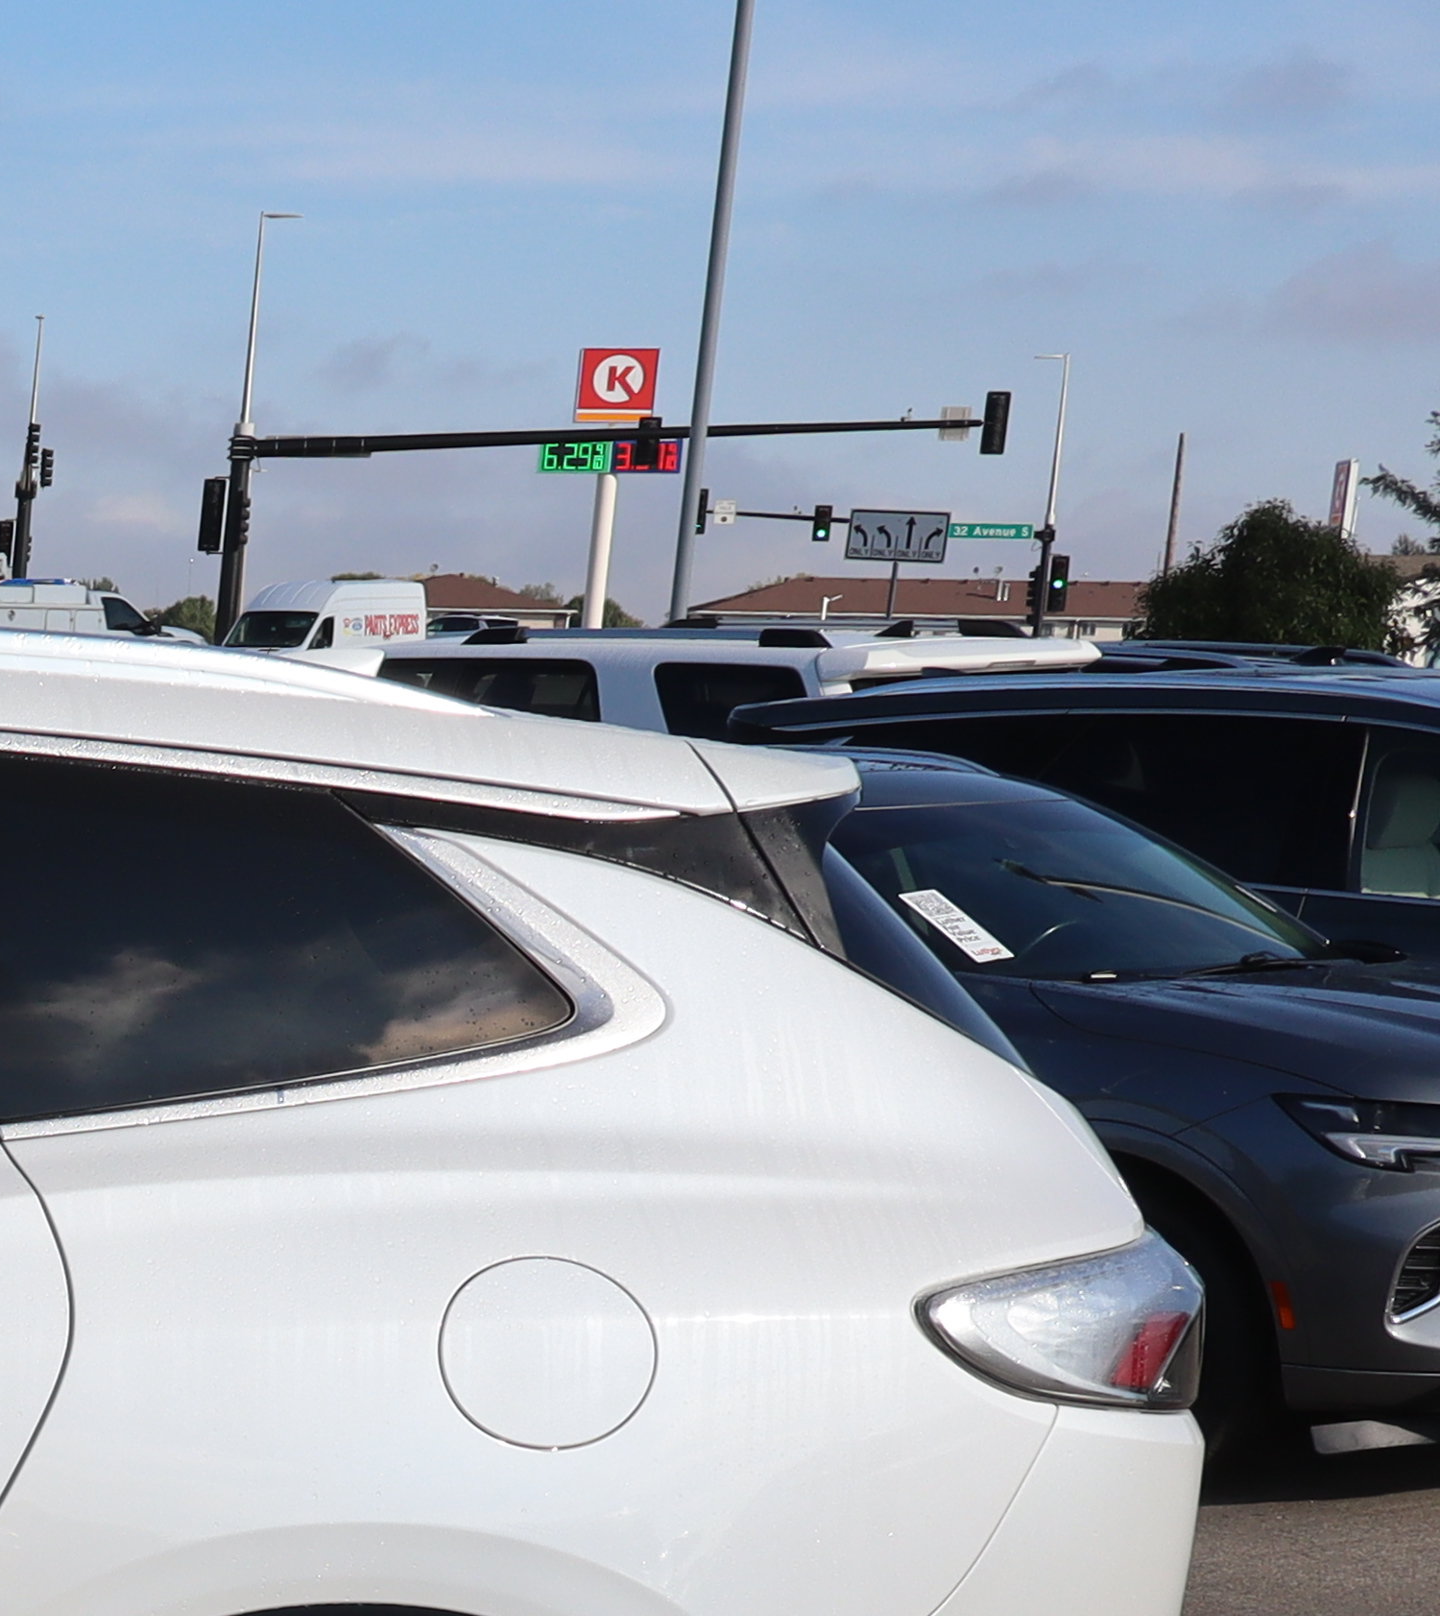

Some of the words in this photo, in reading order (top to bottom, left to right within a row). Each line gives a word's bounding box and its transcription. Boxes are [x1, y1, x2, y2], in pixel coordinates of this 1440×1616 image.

[953, 525, 969, 536] 32
[972, 526, 1016, 537] Avenue
[1021, 527, 1029, 537] S
[364, 615, 388, 636] PARTS
[389, 613, 419, 635] EXPRESS
